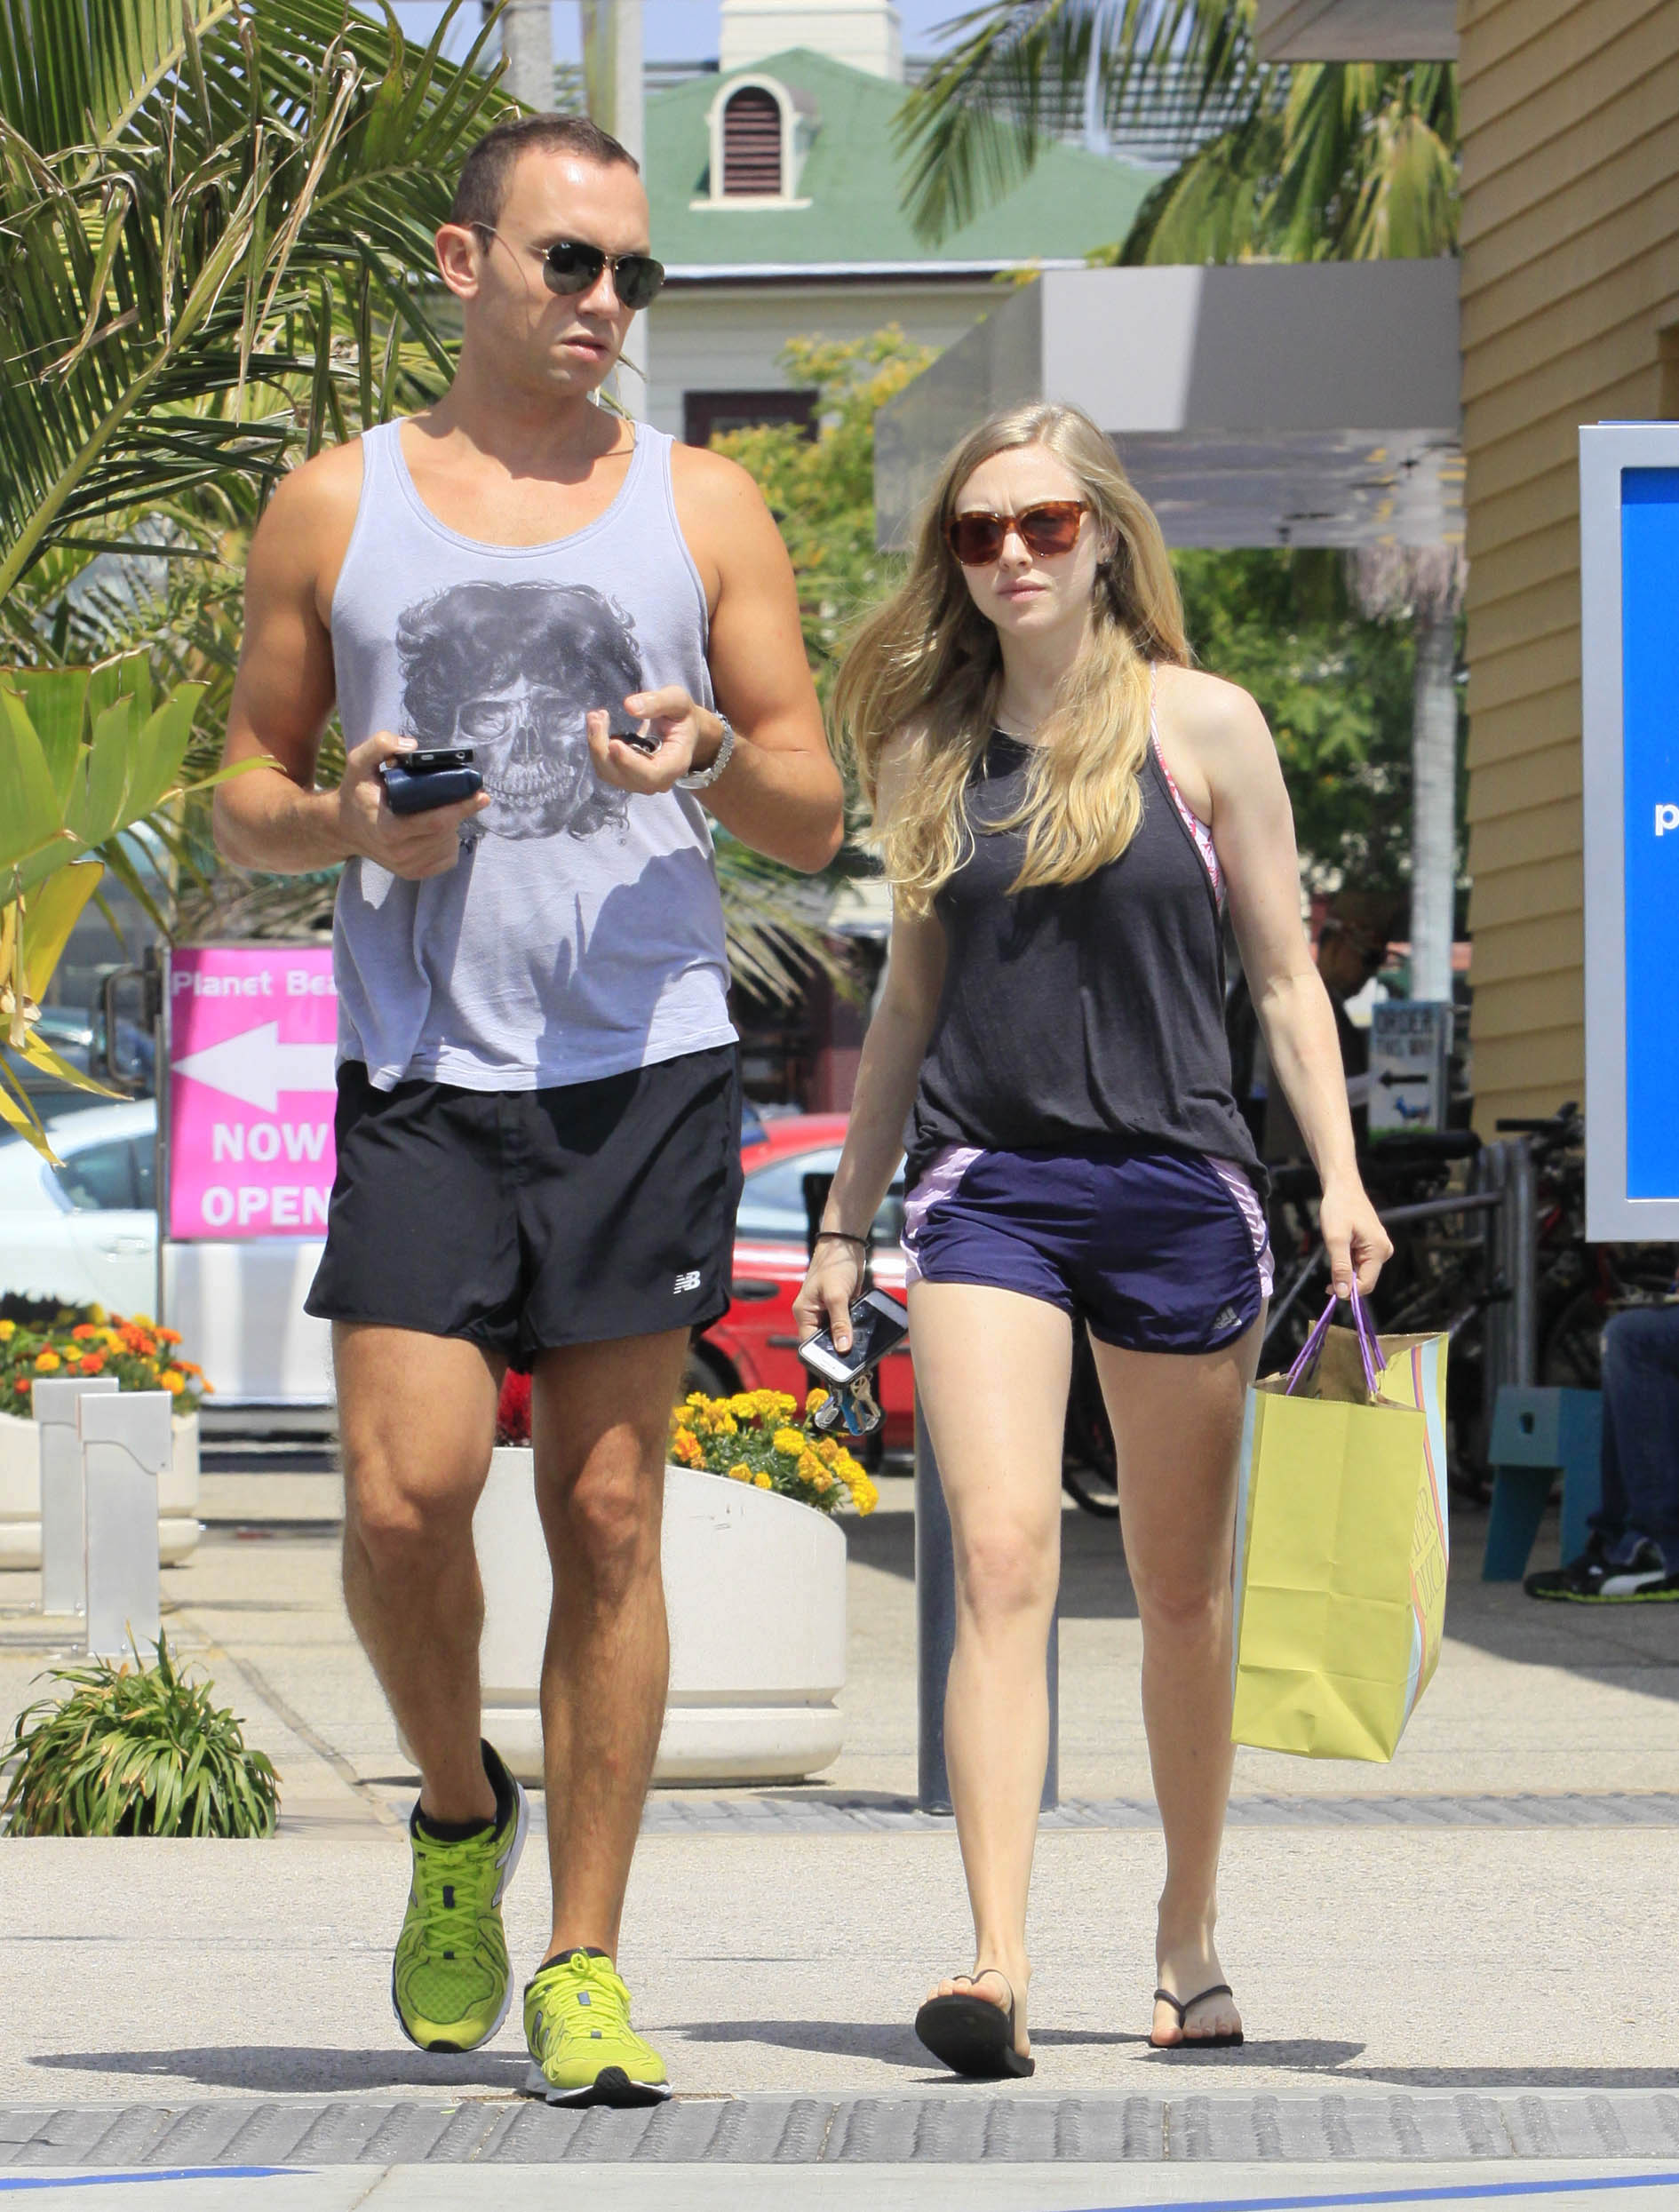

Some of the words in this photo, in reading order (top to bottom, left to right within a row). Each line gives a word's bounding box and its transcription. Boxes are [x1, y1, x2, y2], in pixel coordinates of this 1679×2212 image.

[171, 970, 274, 997] Planet
[213, 1123, 330, 1163] NOW
[201, 1186, 333, 1227] OPEN
